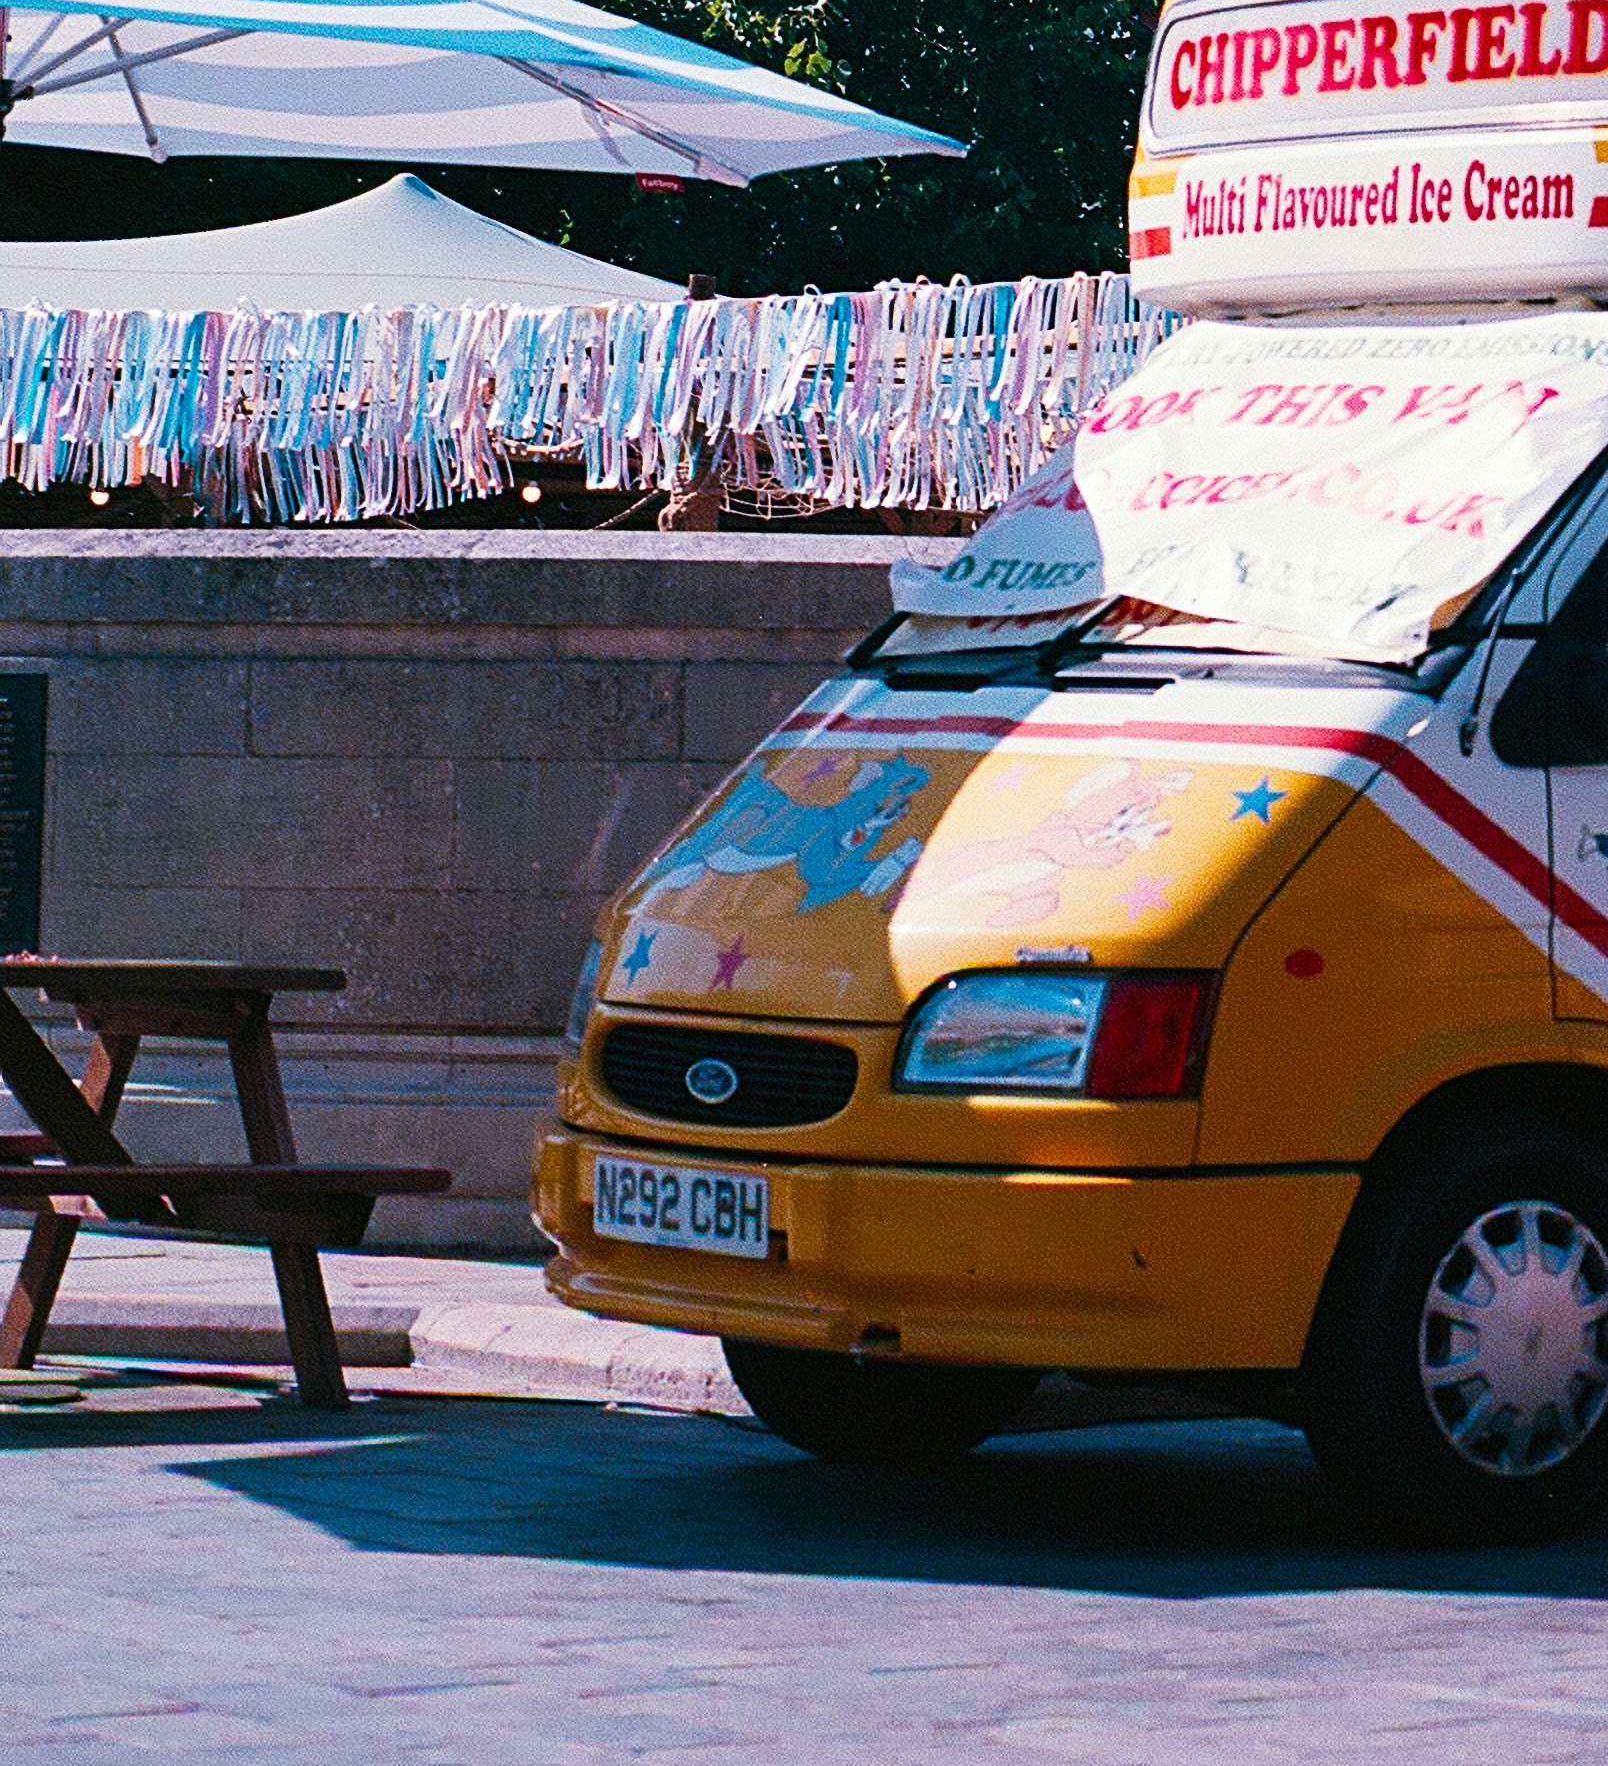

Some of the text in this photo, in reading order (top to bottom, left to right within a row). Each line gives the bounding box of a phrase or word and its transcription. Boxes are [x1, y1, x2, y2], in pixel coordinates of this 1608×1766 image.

[1182, 159, 1574, 239] Multi Flavoured Ice Cream
[1082, 379, 1561, 438] OOK THIS VAN
[597, 1163, 764, 1244] N292 CBH
